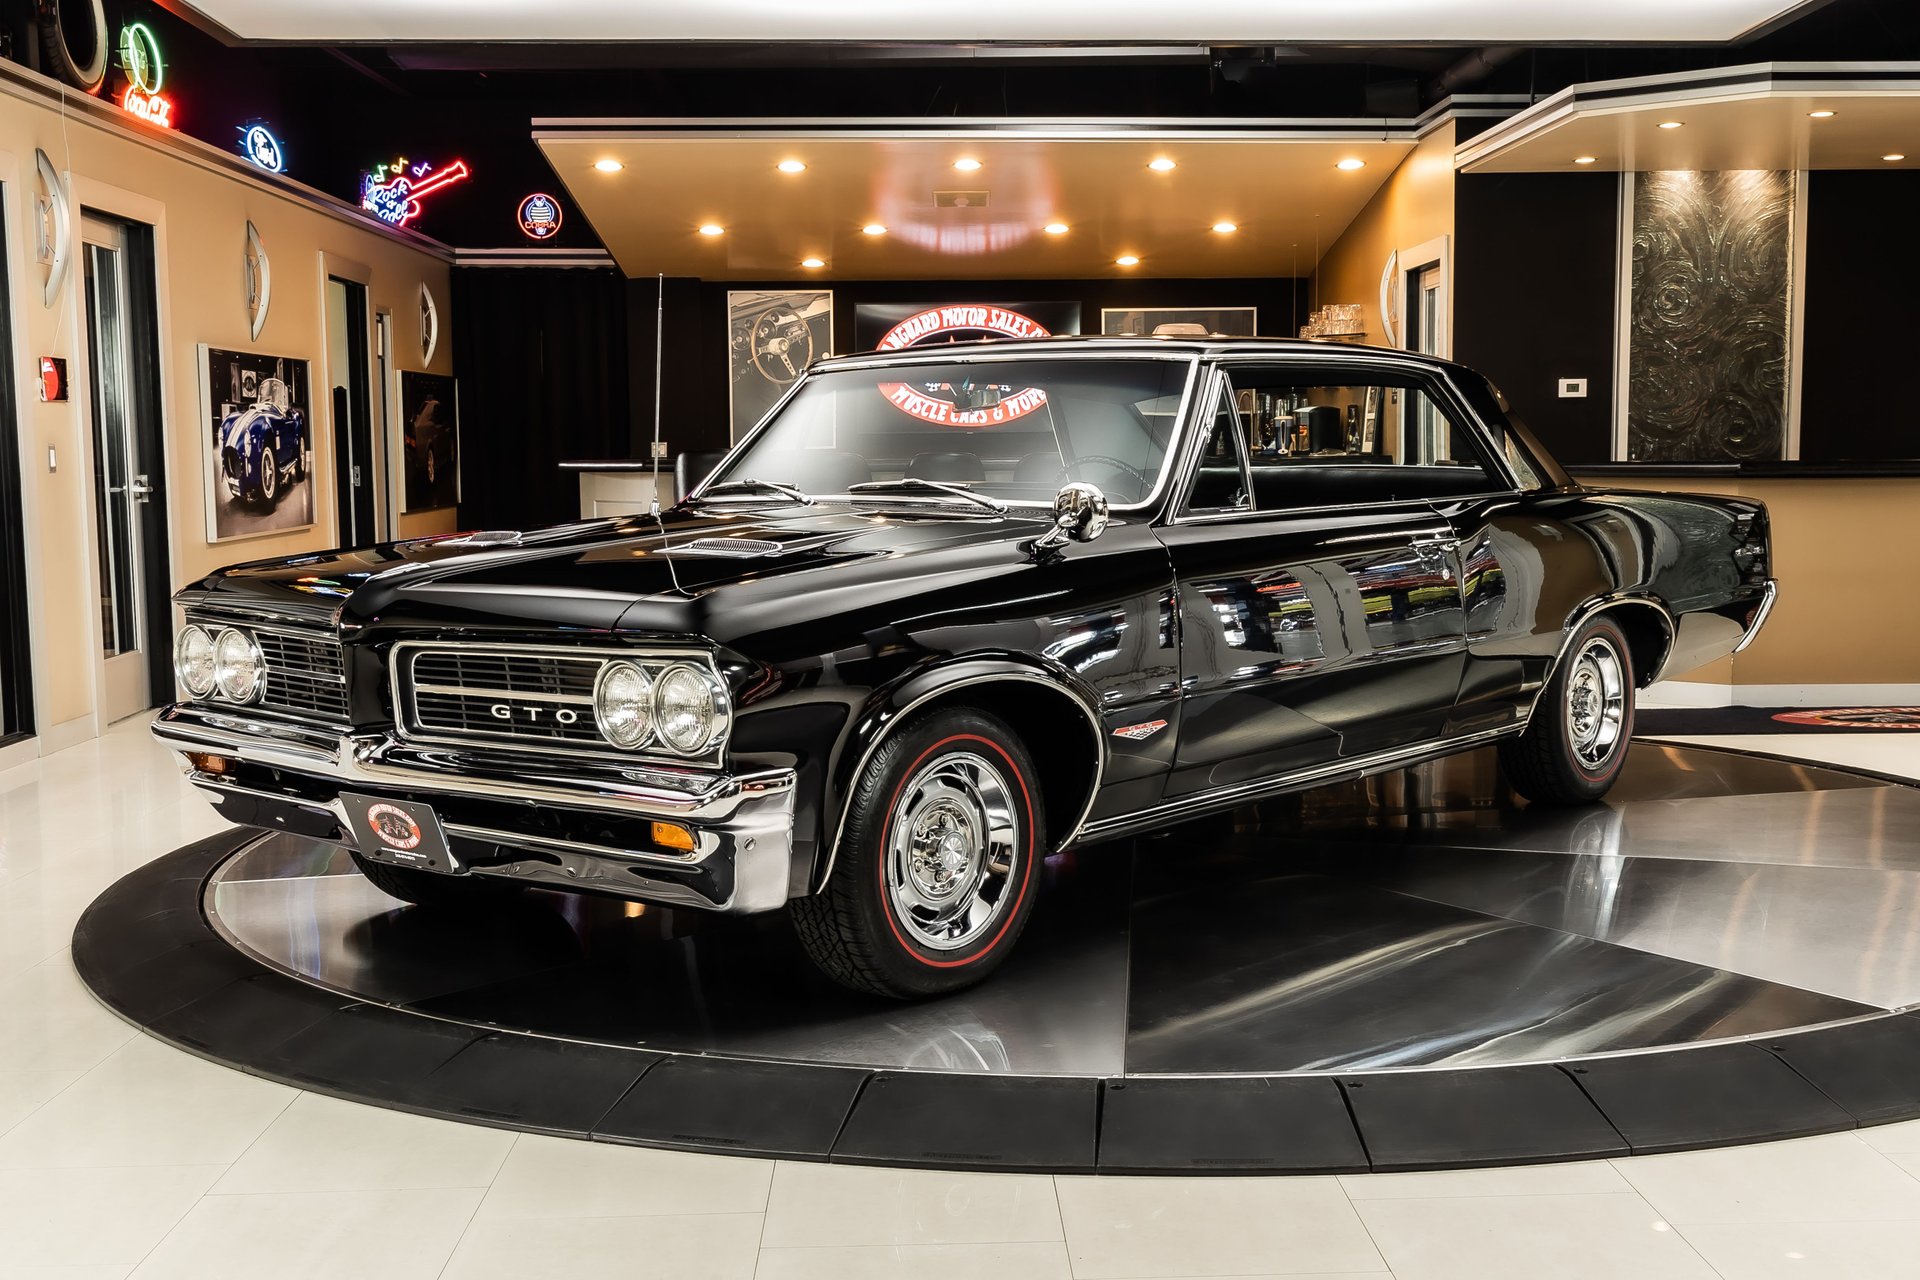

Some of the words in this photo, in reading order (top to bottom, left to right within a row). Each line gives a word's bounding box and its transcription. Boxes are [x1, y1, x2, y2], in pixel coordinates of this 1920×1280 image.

[372, 180, 408, 204] Rock
[524, 221, 556, 229] COBRA
[940, 307, 988, 328] MOTOR
[890, 386, 949, 422] MUSCLE
[491, 704, 577, 724] GTO
